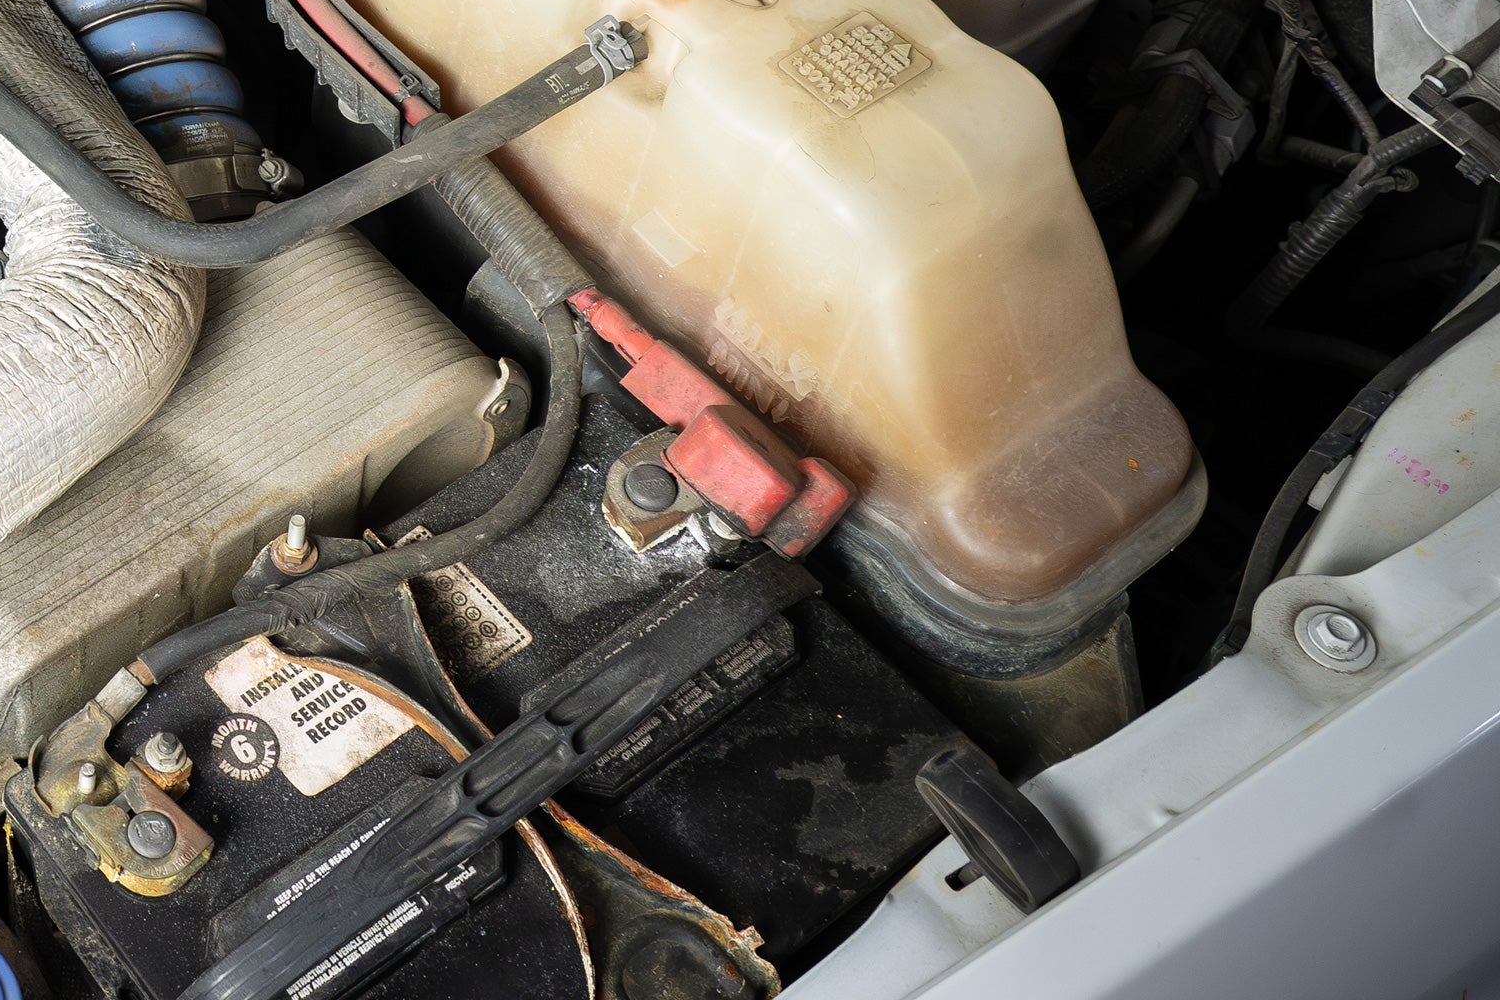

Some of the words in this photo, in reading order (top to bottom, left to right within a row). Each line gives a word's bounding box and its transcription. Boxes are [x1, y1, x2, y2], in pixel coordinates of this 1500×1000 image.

[239, 657, 307, 707] INSTALL
[288, 671, 326, 700] AND
[288, 677, 356, 727] SERVICE
[211, 717, 260, 750] MONTH
[304, 696, 369, 743] RECORD
[217, 738, 278, 781] WARRANTY
[232, 735, 254, 762] 6
[607, 738, 631, 757] CAUSE
[273, 888, 294, 906] KEEP
[290, 878, 307, 893] OUT
[304, 871, 317, 883] OF
[314, 861, 331, 876] THE
[327, 846, 352, 866] REACH
[349, 839, 361, 850] OF
[444, 865, 477, 891] RECYCLE
[285, 959, 331, 995] INSTRUCTIONS
[335, 935, 364, 958] VEHICLE
[360, 917, 389, 939] OWNERS
[297, 984, 314, 998] NOT
[310, 961, 346, 989] AVAILABLE
[357, 931, 386, 954] SERVICE
